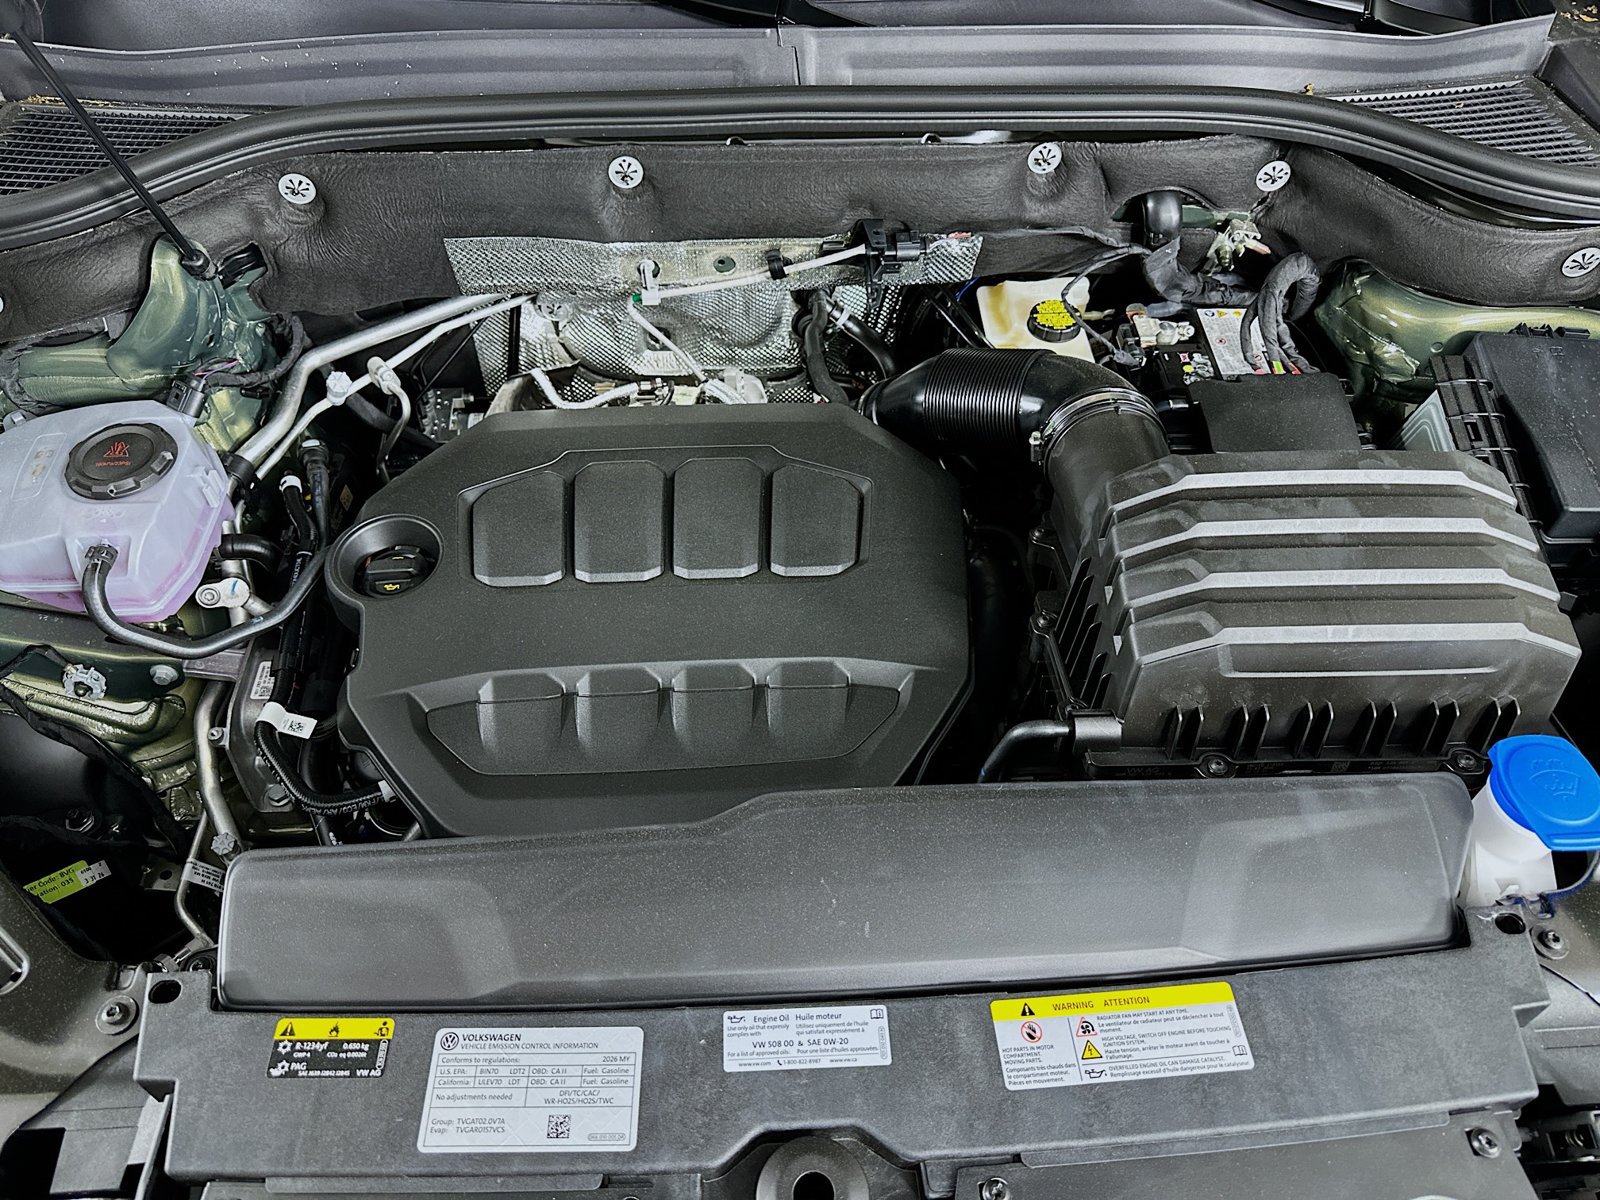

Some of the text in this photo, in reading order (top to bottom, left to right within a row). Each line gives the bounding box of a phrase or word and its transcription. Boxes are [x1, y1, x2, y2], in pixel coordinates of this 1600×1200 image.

[1052, 996, 1150, 1011] WARNING ATTENTION
[754, 1014, 778, 1024] Engine
[796, 1013, 814, 1021] Huile
[462, 1034, 522, 1042] VOLKSWAGEN
[295, 1041, 370, 1051] R-1234yf 0.650 kg
[767, 1040, 782, 1048] 508
[823, 1037, 849, 1046] 0W-20
[482, 1056, 520, 1065] regulations:
[290, 1062, 307, 1070] PAG
[1013, 1071, 1049, 1079] compartiment
[446, 1094, 487, 1102] adjustments
[431, 1118, 454, 1126] Group:
[430, 1126, 448, 1134] Evap:
